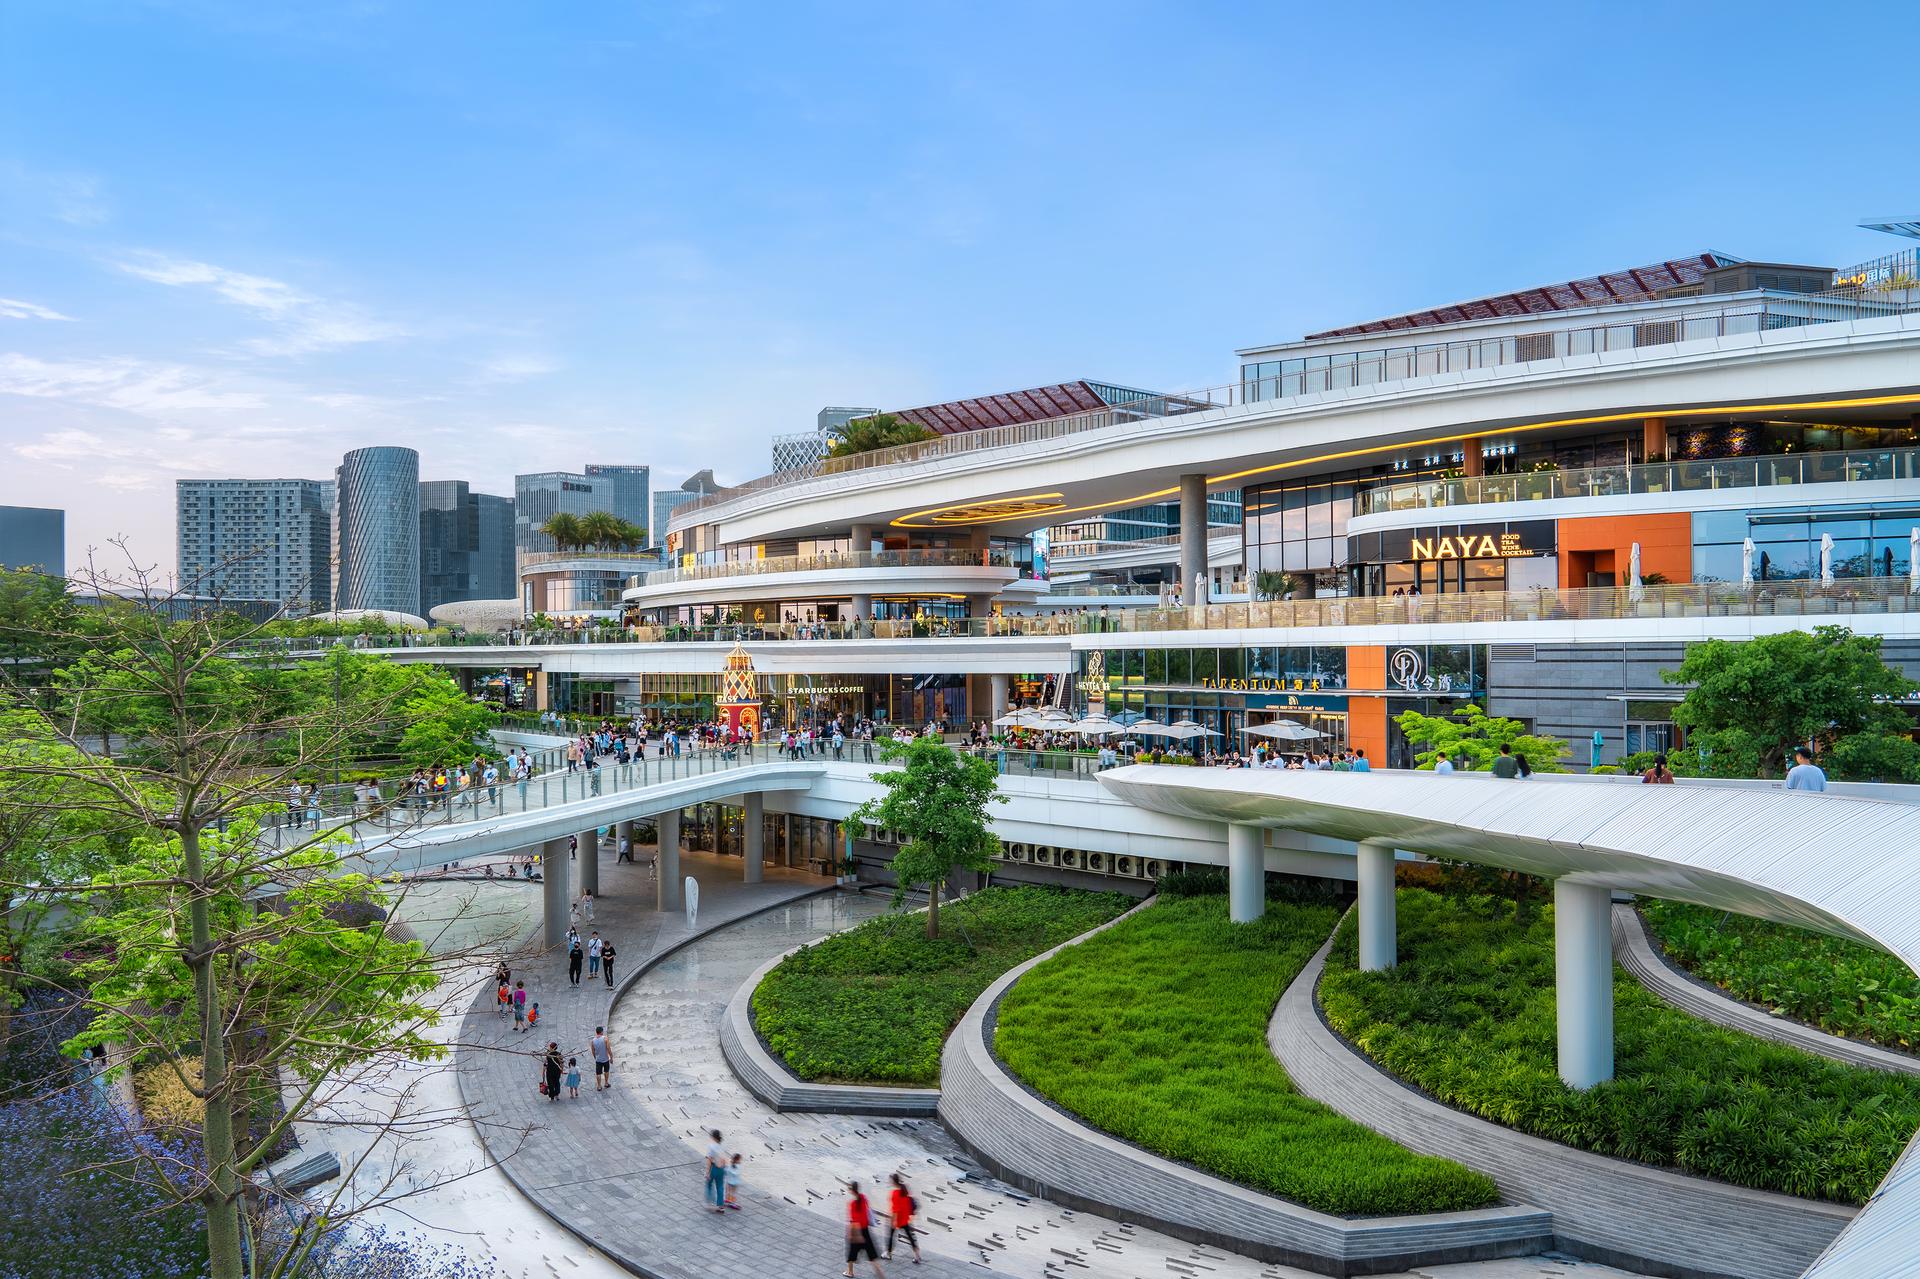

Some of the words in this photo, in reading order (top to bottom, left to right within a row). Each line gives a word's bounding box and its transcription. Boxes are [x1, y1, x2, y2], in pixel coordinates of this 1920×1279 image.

[1411, 535, 1500, 559] NAYA
[1078, 681, 1099, 690] HEYTEA
[1201, 677, 1286, 691] TARENTUM
